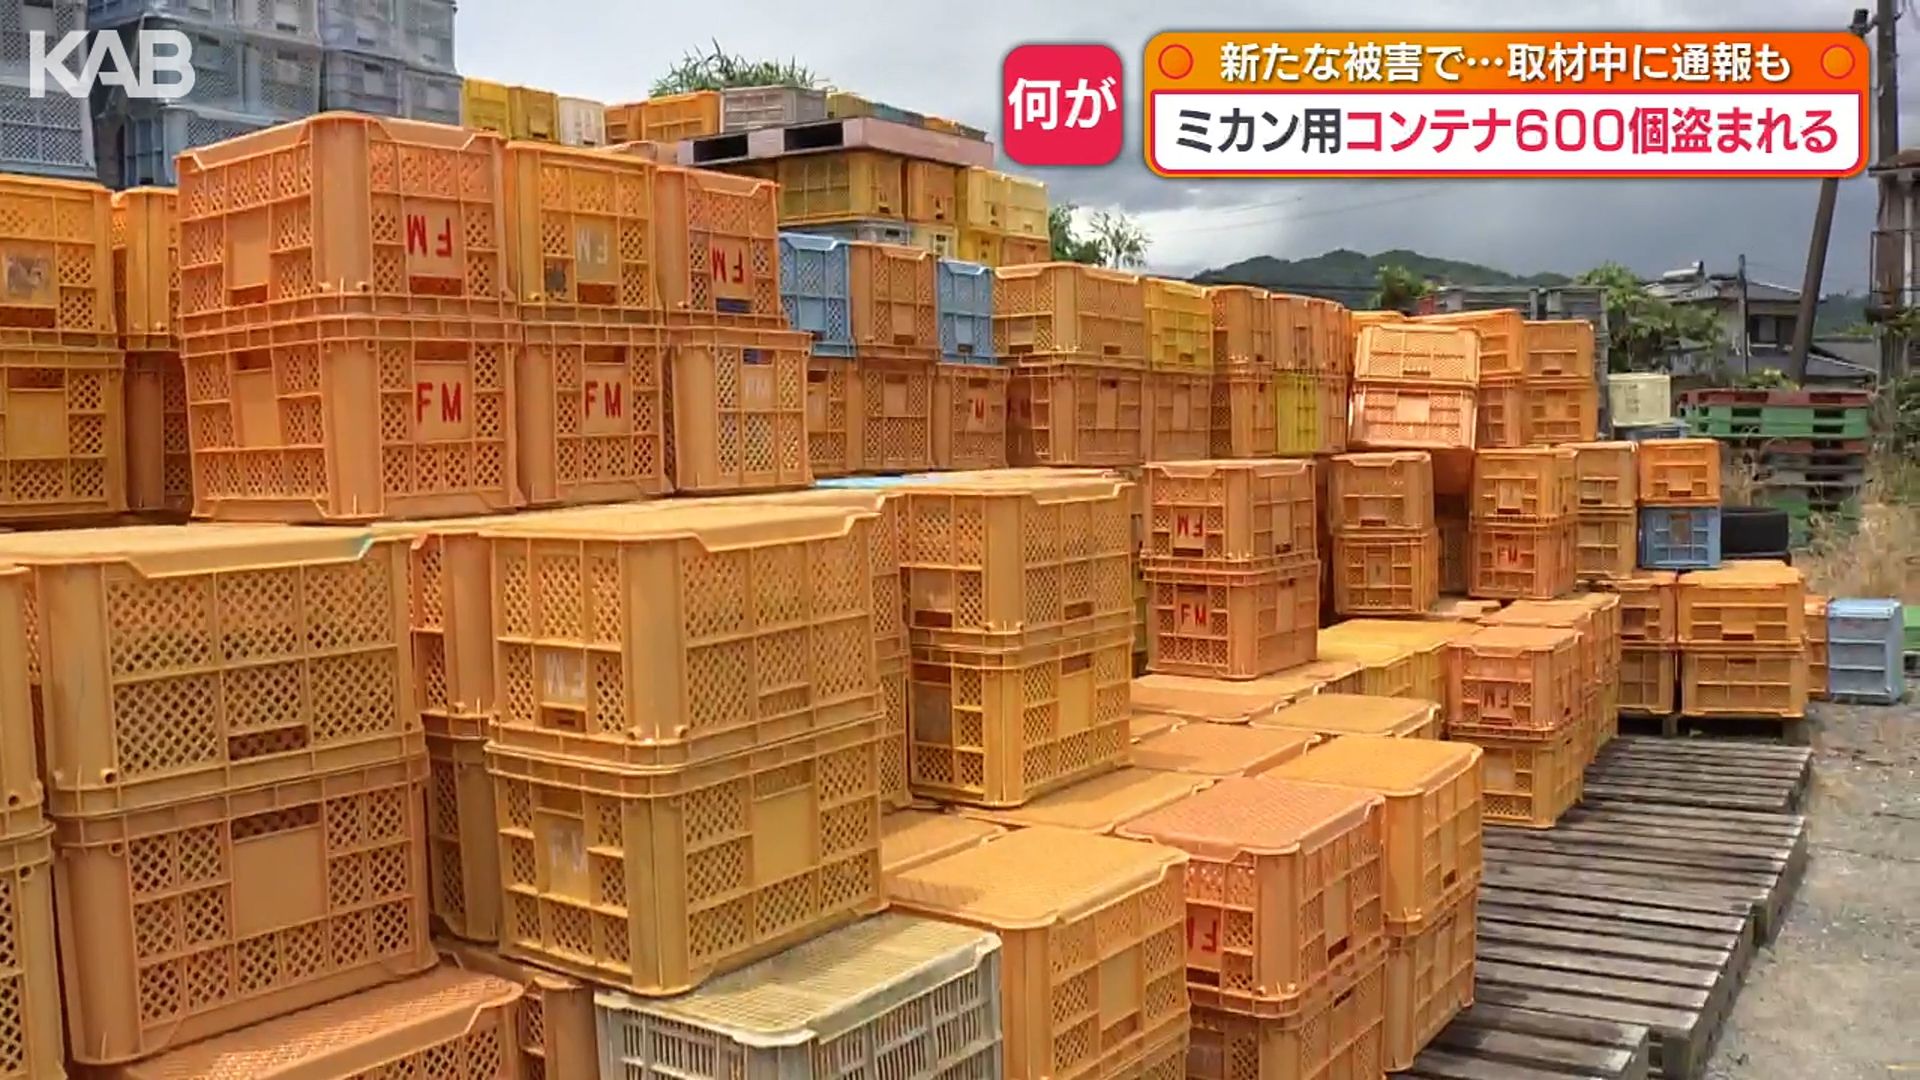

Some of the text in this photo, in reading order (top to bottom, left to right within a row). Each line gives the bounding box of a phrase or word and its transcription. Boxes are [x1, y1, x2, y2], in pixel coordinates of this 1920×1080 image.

[407, 215, 452, 258] FM
[711, 247, 743, 284] FM
[416, 381, 461, 424] FM
[585, 380, 621, 419] FM
[1177, 515, 1204, 537] FM
[1180, 603, 1206, 627] FM
